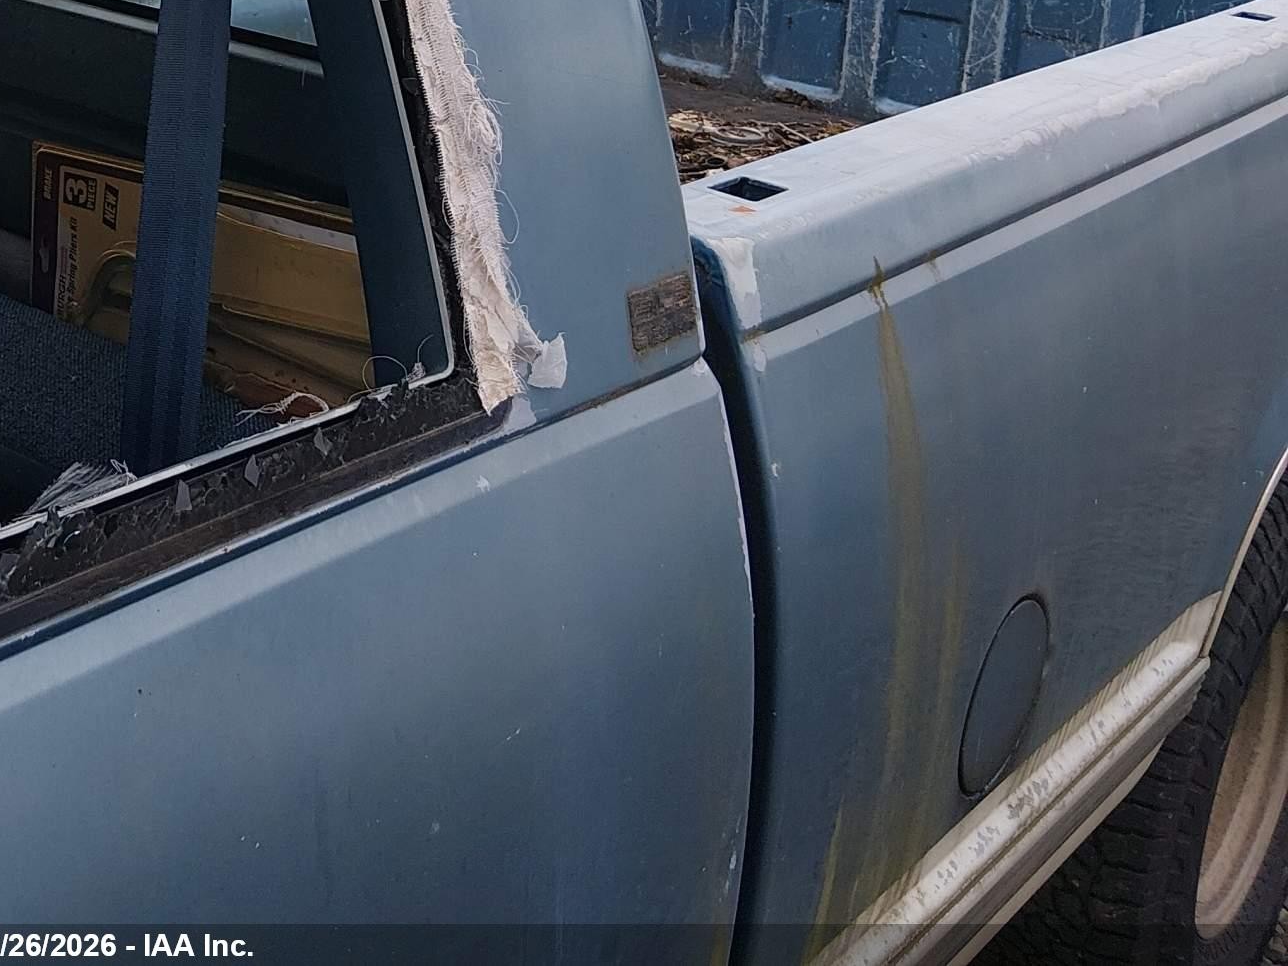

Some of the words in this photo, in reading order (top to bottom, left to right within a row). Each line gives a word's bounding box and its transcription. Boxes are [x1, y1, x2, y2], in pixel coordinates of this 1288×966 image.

[43, 167, 53, 201] BRAKE
[65, 178, 88, 204] 3
[86, 178, 97, 210] PIECE
[70, 216, 78, 228] Kit
